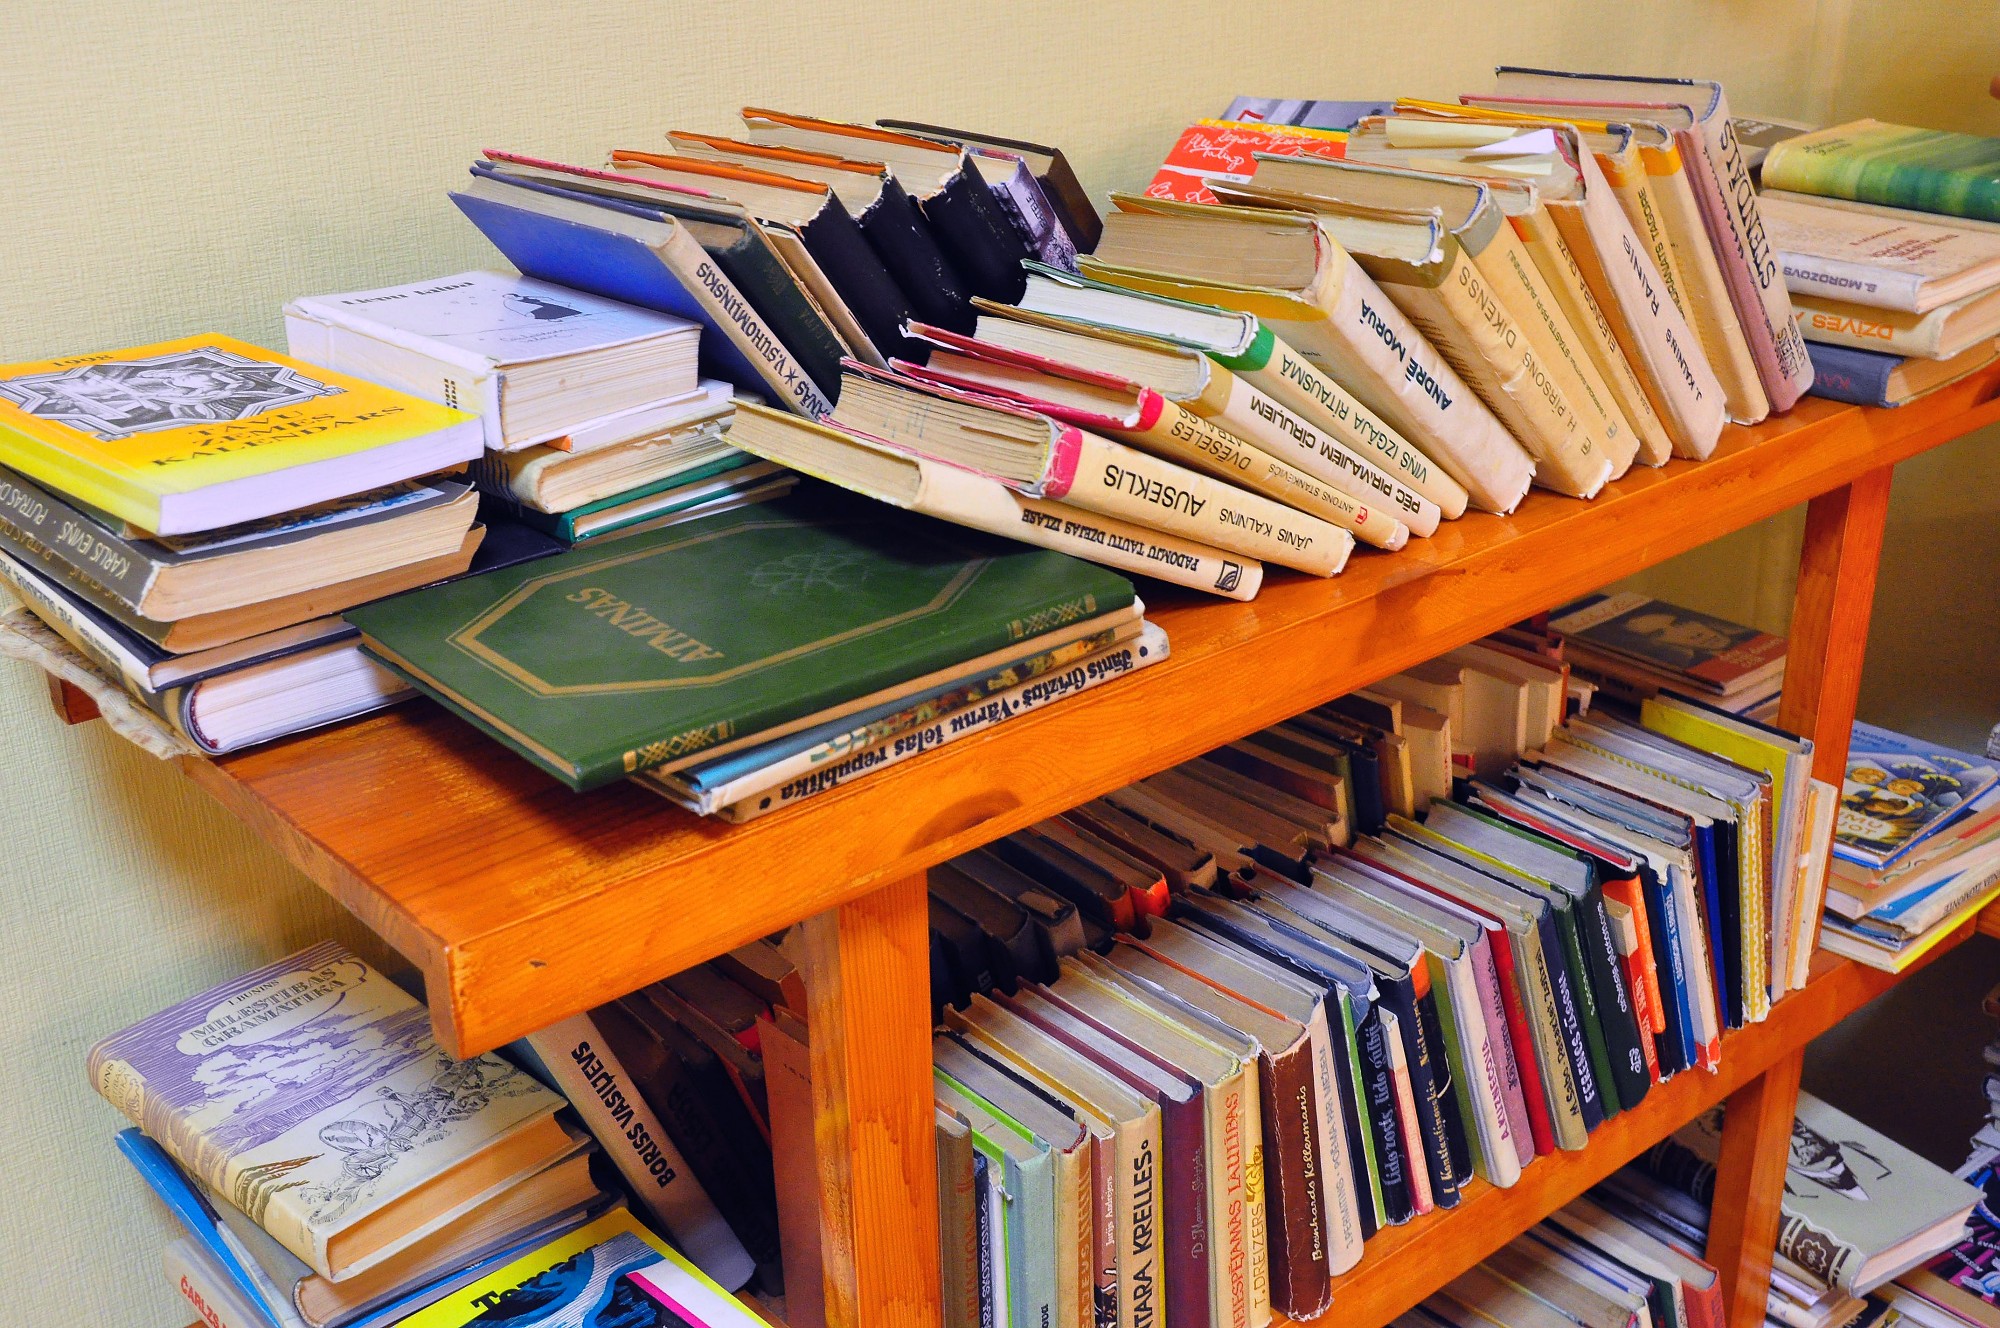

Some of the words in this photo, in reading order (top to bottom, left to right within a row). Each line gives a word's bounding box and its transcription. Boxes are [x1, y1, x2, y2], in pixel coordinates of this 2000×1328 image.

[1719, 119, 1776, 290] STENDĀLS
[1621, 233, 1660, 318] RAINIS
[1782, 266, 1862, 292] MOROZOVS
[1358, 298, 1407, 362] MORUĀ
[1458, 265, 1517, 349] DIKENSS
[1811, 313, 1895, 342] DZĪVES
[1280, 354, 1350, 421] RĪTAUSMĀ
[1404, 357, 1453, 411] ANDRĒ
[151, 404, 405, 466] KALENDARS
[187, 409, 305, 437] TAVU
[192, 412, 338, 447] ZEMES
[1170, 422, 1252, 470] DVĒSELES
[1353, 412, 1399, 460] IZGĀJA
[1103, 464, 1207, 517] AUSEKLIS
[1320, 494, 1354, 514] ANTONS
[1396, 490, 1421, 515] PĒC
[1021, 507, 1061, 531] IZLASE
[1064, 519, 1106, 543] DZEJAS
[1277, 527, 1313, 552] JĀNIS
[1107, 535, 1145, 560] TAUTU
[1147, 547, 1200, 572] PADOMJU
[893, 725, 945, 760] ielas
[780, 739, 889, 800] republika
[201, 979, 347, 1048] GRAMATIKA
[570, 1041, 635, 1130] VASIĻJEVS
[1571, 1037, 1595, 1104] FERENCS
[626, 1122, 677, 1189] BORISS
[1225, 1091, 1243, 1197] LAULĪBAS
[1295, 1085, 1316, 1180] Kellermanis
[1305, 1180, 1323, 1262] Bernhards
